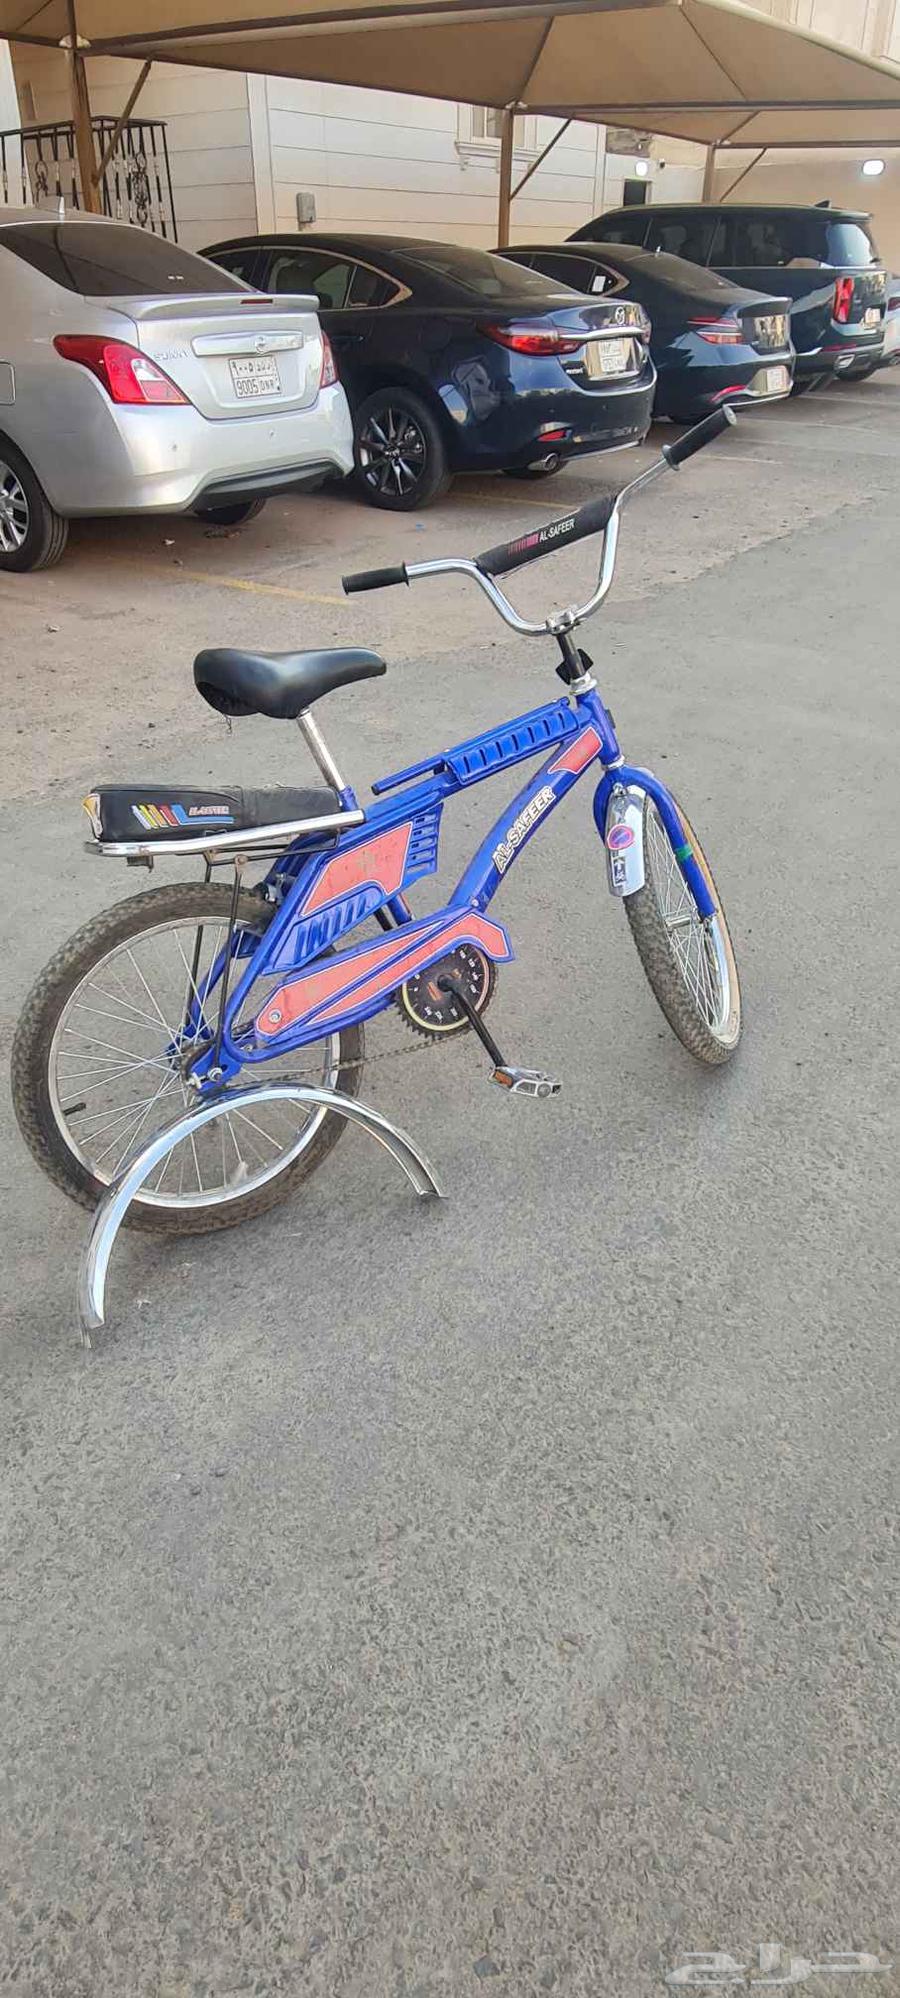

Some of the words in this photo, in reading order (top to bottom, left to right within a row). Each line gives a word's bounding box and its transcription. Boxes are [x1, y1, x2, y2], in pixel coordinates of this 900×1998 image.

[236, 378, 259, 396] 9005
[539, 518, 576, 542] AL-SAFEER
[492, 786, 557, 874] AL-SAFEER
